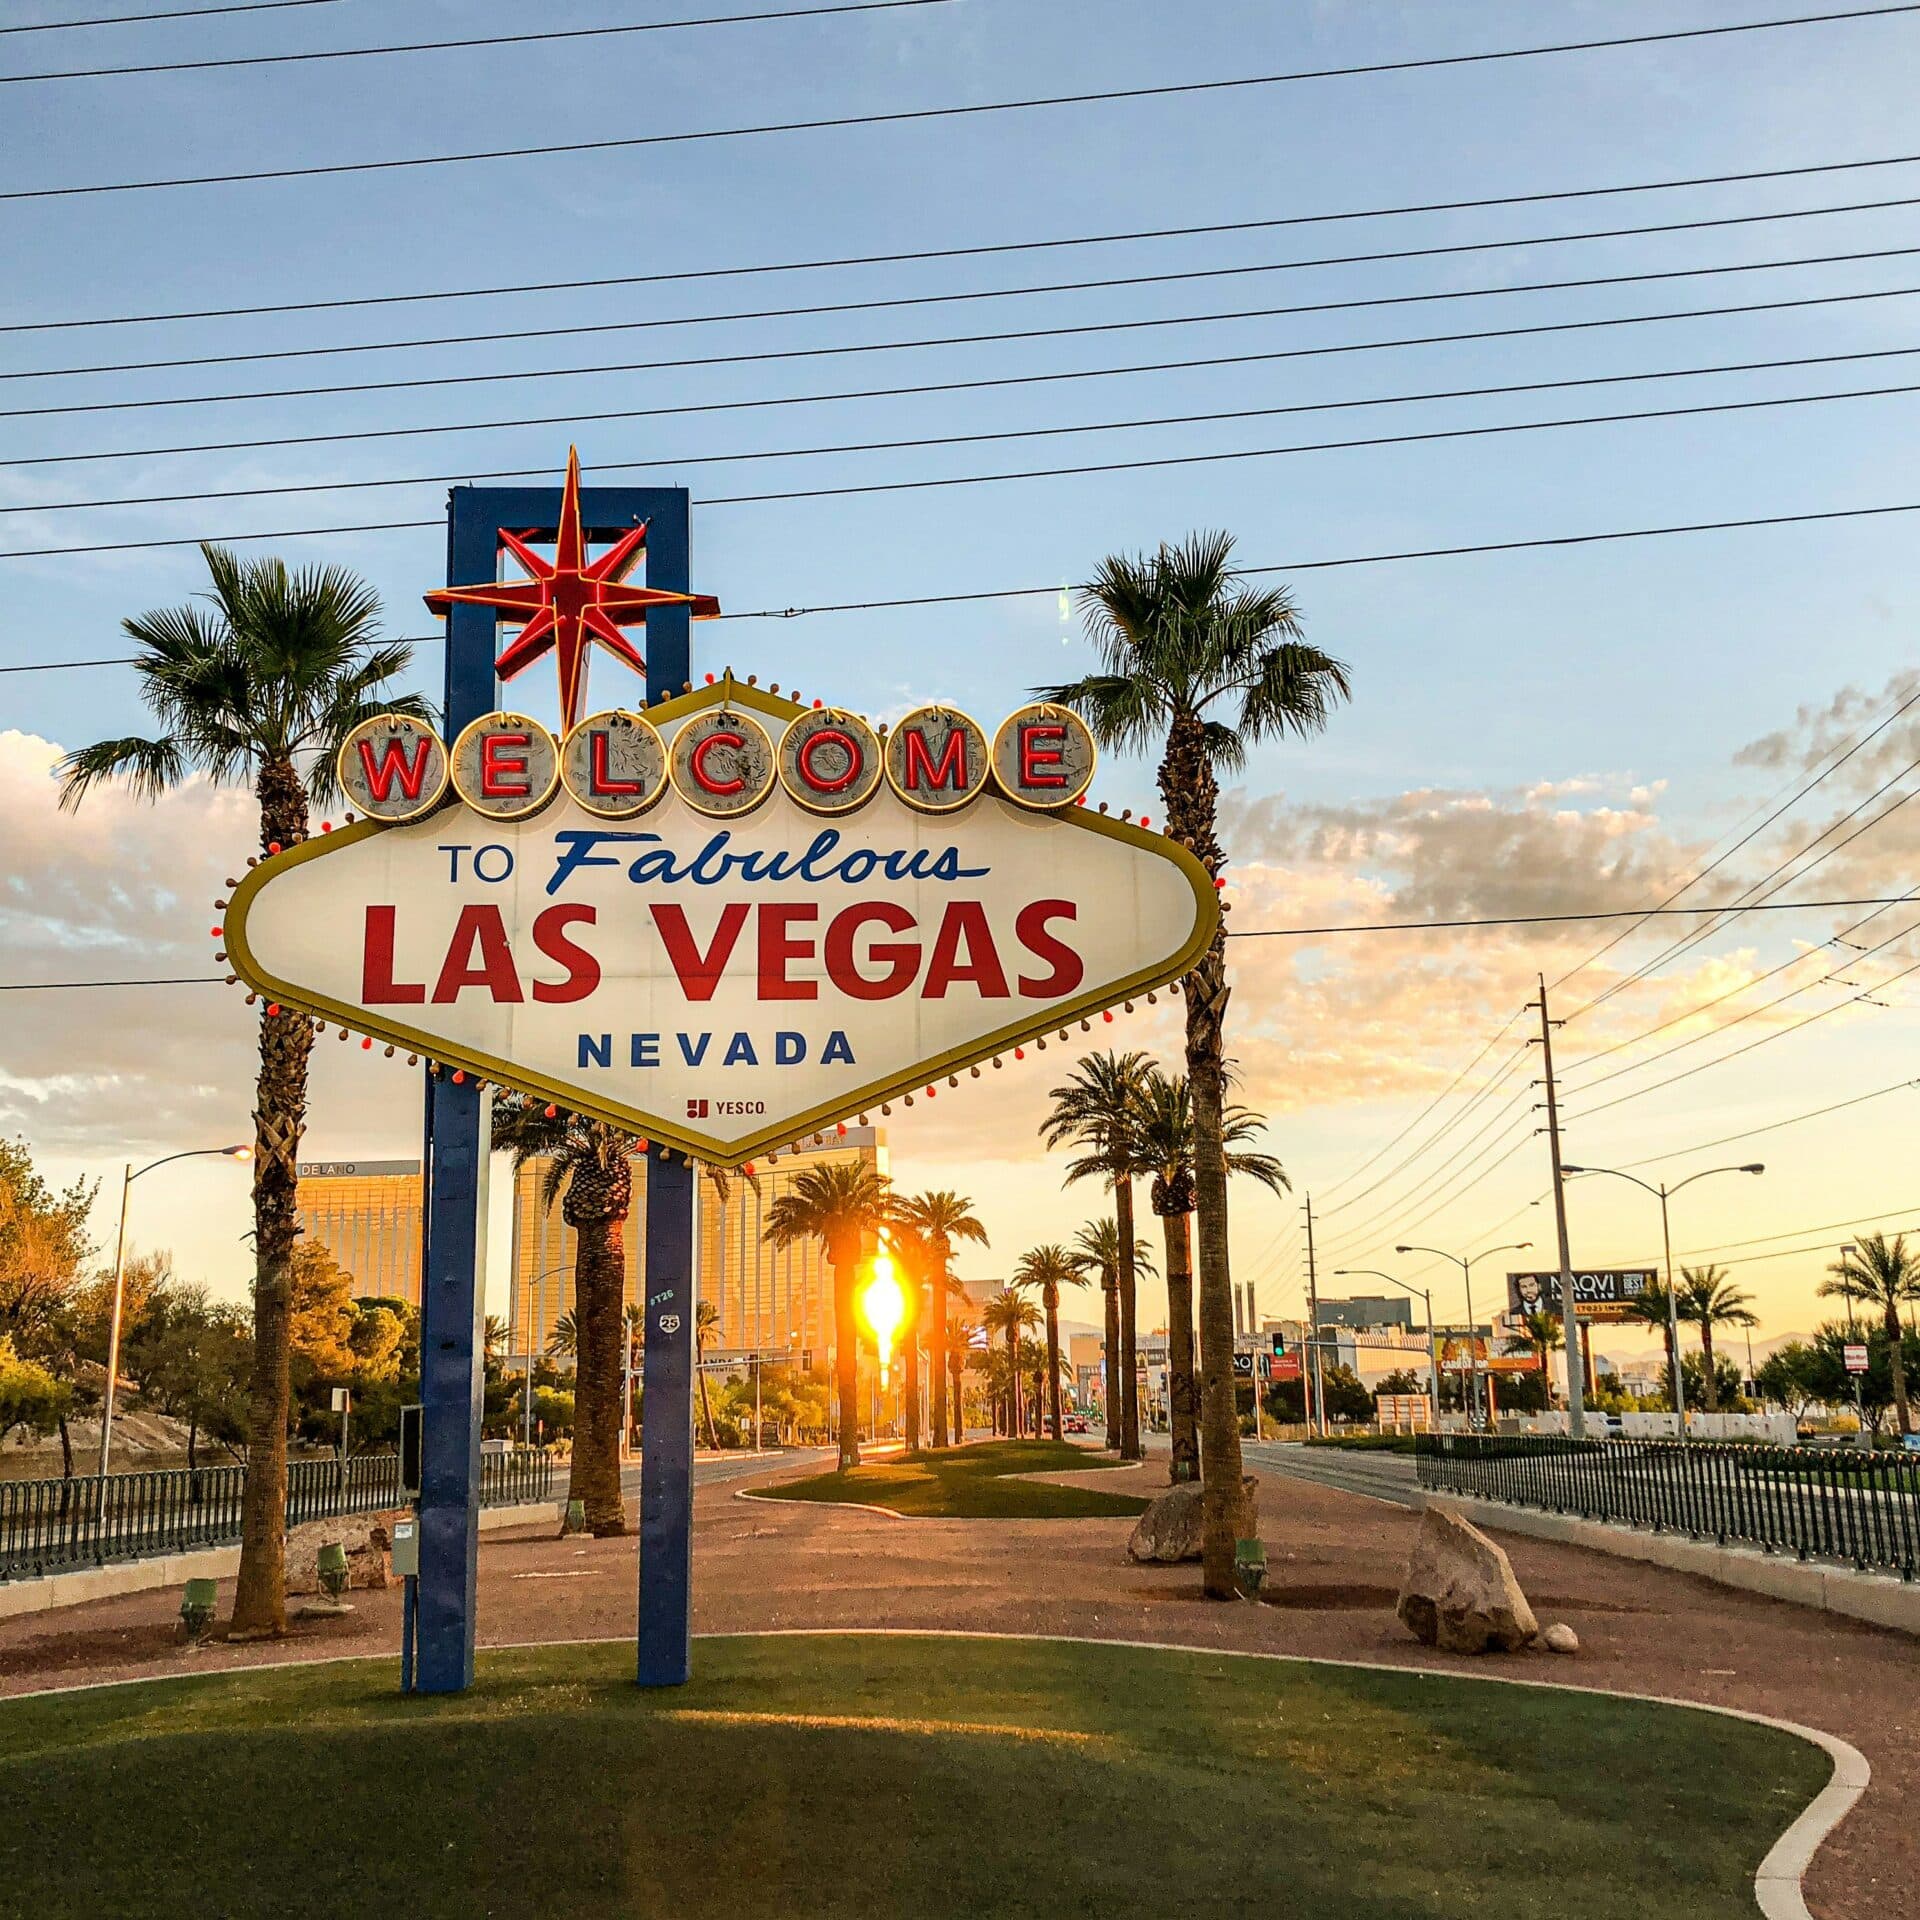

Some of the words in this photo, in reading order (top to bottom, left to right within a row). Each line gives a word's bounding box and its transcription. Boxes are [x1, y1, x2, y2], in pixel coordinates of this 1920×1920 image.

[358, 722, 1068, 801] WELCOME
[438, 845, 514, 882] TO
[546, 829, 991, 895] Fabulous
[362, 903, 601, 1004] LAS
[649, 899, 1084, 1001] VEGAS
[578, 1031, 855, 1067] NEVADA
[716, 1101, 765, 1115] YESCO
[302, 1164, 355, 1176] DELANO
[662, 1319, 678, 1328] 25
